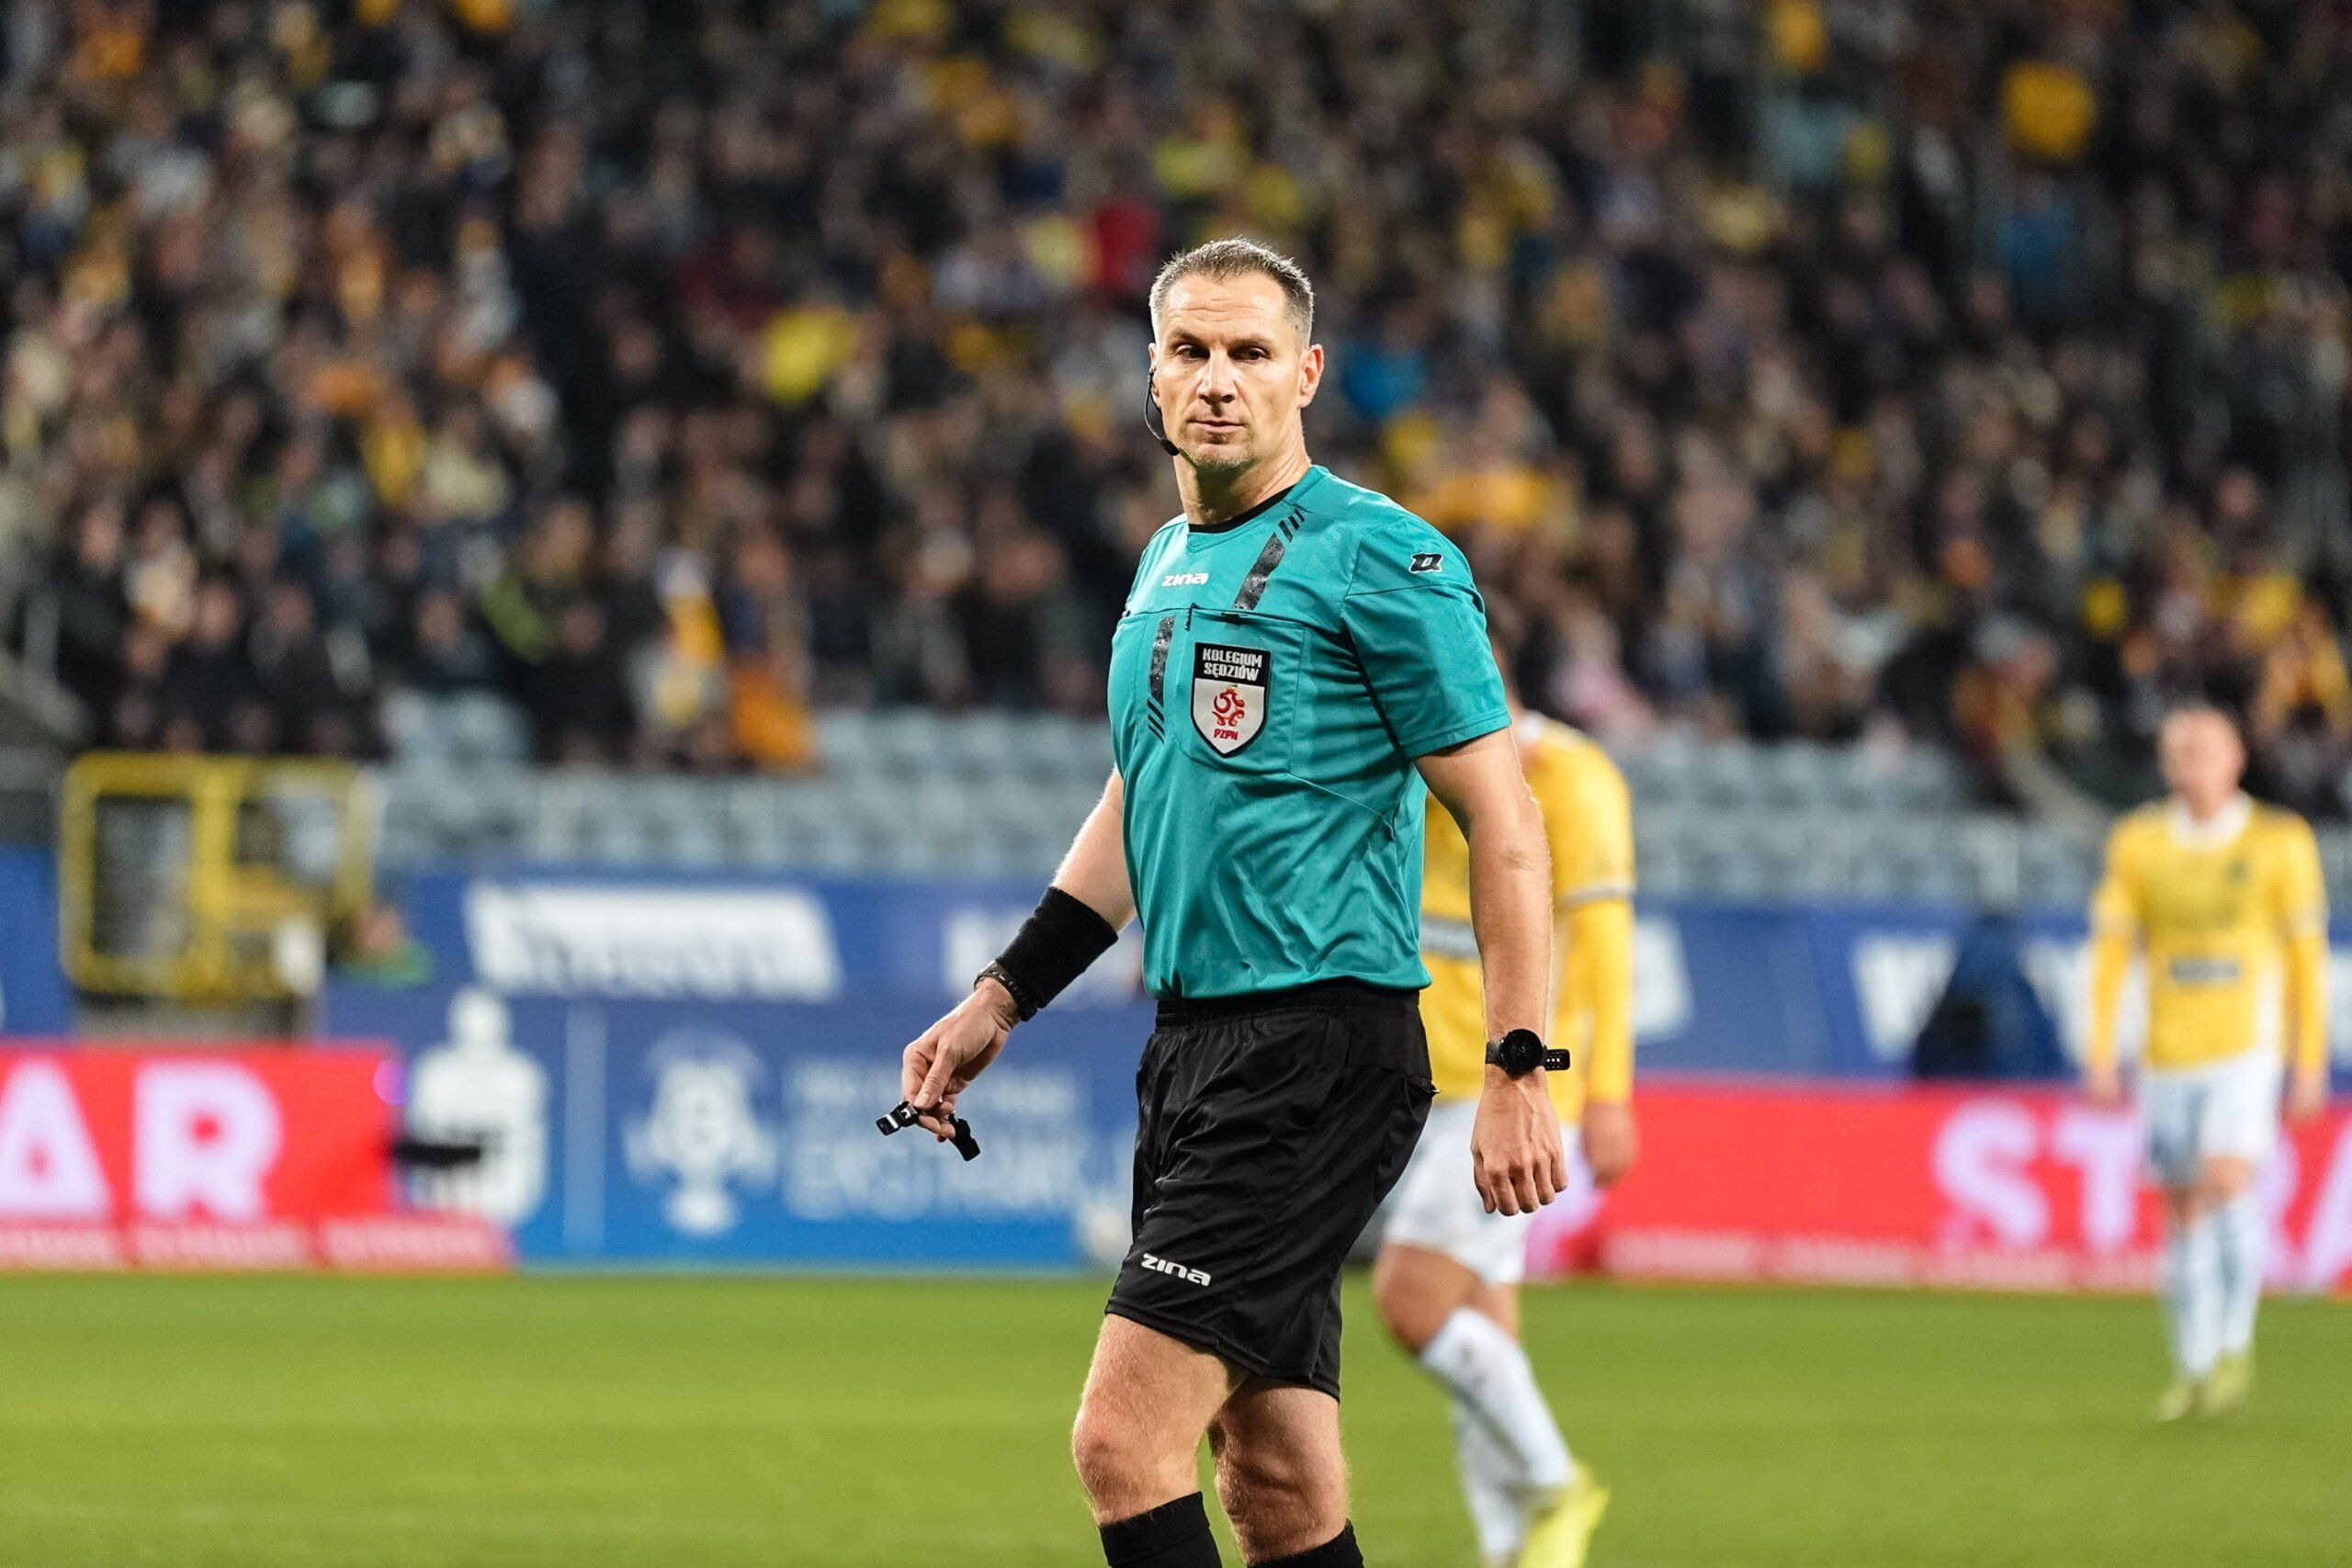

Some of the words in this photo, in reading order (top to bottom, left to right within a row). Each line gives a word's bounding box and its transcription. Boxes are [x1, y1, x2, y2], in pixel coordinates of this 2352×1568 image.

[1202, 648, 1263, 669] KOLEGIUM
[1203, 661, 1260, 682] SĘDZIÓW
[1214, 728, 1238, 740] PZPN
